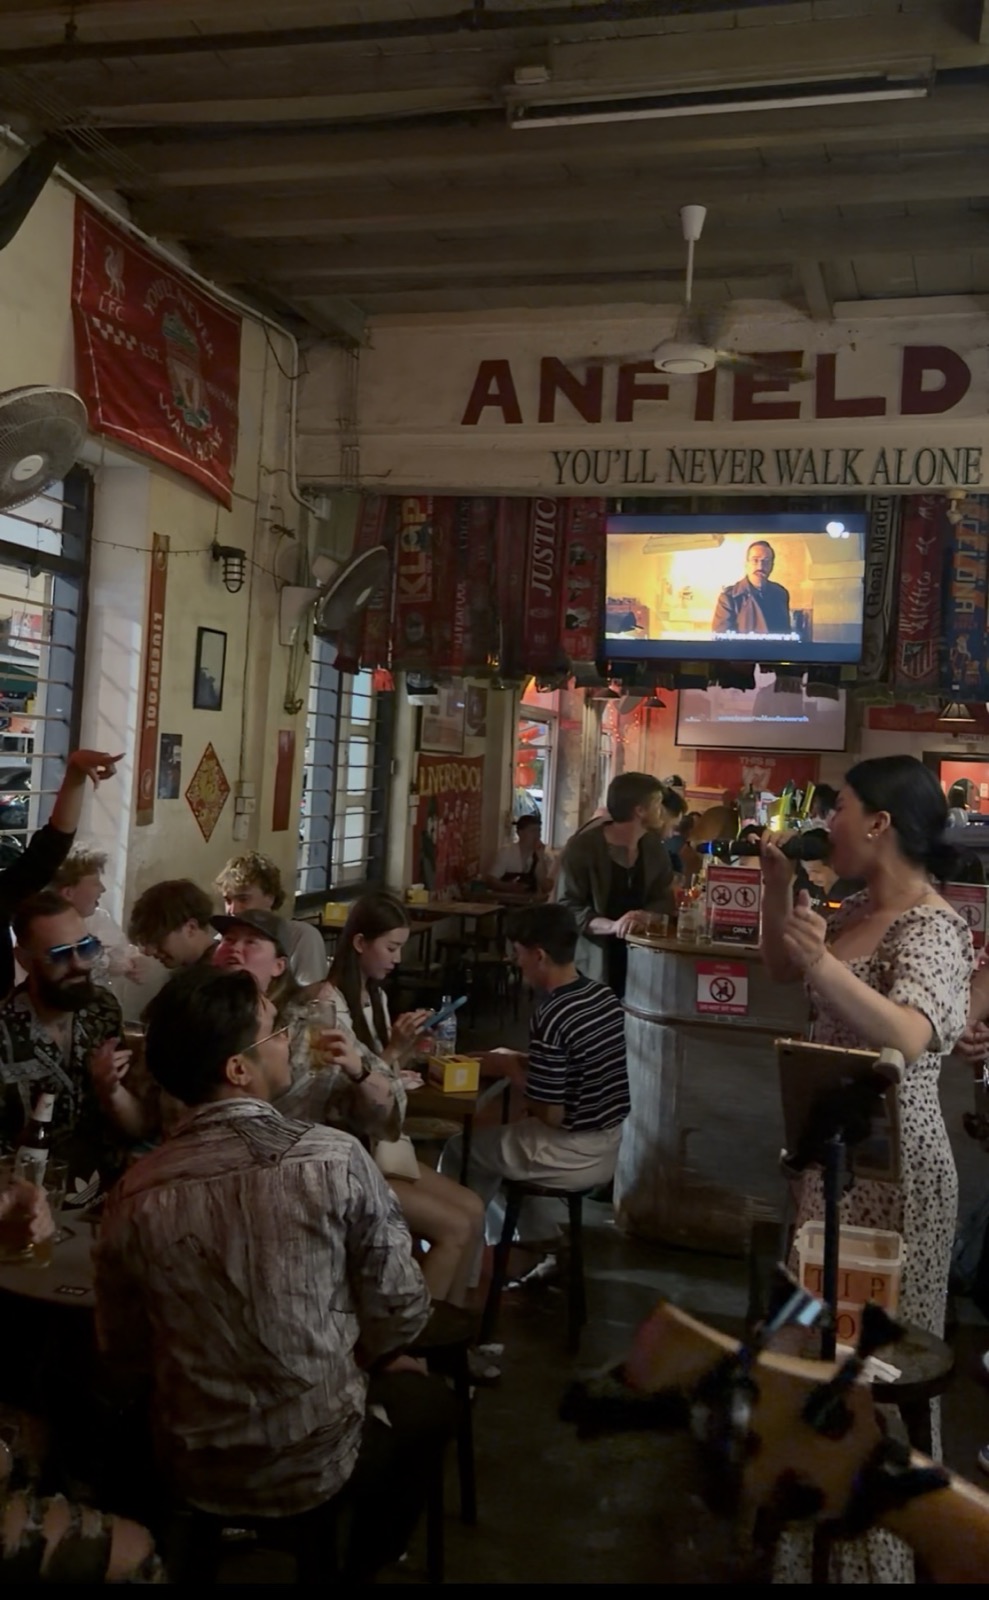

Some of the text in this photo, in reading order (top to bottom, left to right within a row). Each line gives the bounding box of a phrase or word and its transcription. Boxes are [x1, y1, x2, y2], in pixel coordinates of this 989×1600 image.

[98, 295, 126, 322] LFC
[460, 346, 971, 425] ANFIELD
[552, 445, 984, 486] YOU'LL NEVER WALK ALONE
[531, 496, 557, 598] JUSTIC
[866, 561, 883, 607] Real
[146, 611, 163, 730] LIVERPOOL
[732, 926, 755, 936] ONLY
